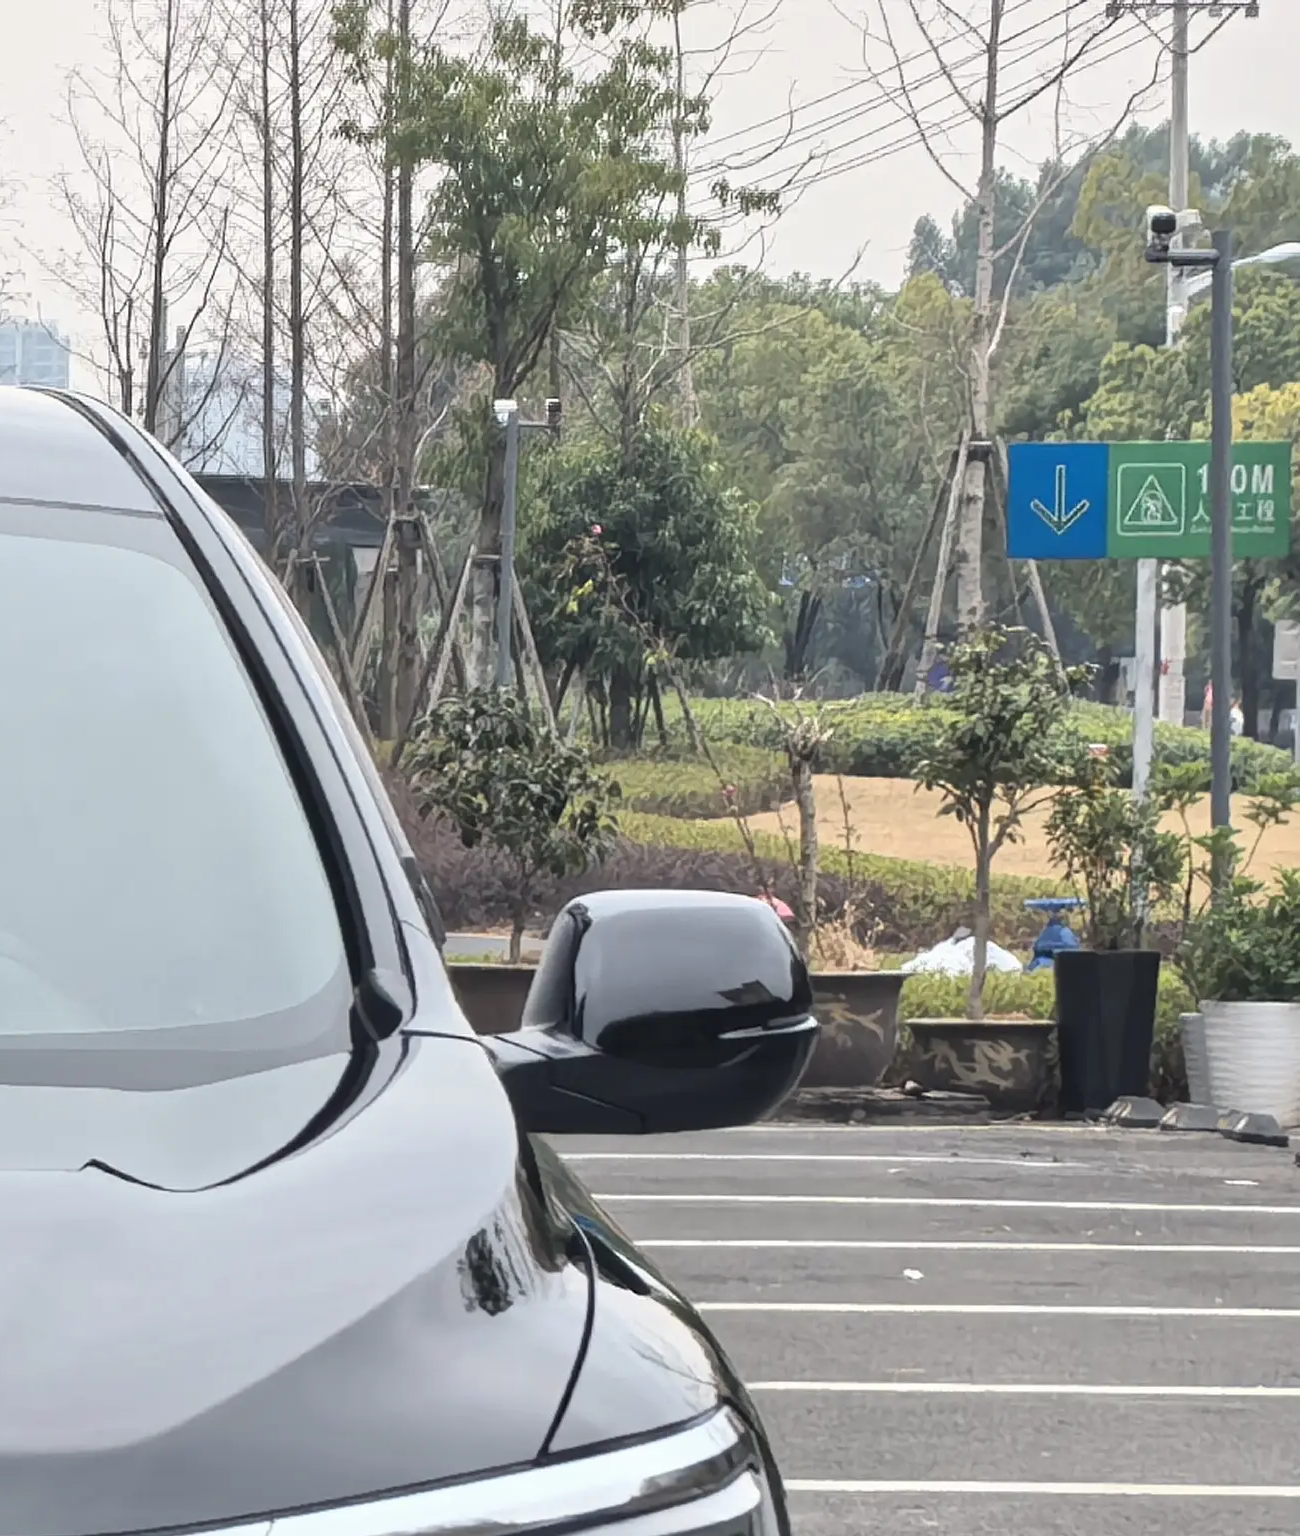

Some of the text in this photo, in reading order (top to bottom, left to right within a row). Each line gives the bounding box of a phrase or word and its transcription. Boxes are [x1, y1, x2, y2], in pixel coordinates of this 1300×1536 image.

[1197, 463, 1274, 494] 10M
[1191, 498, 1276, 522] 人工程
